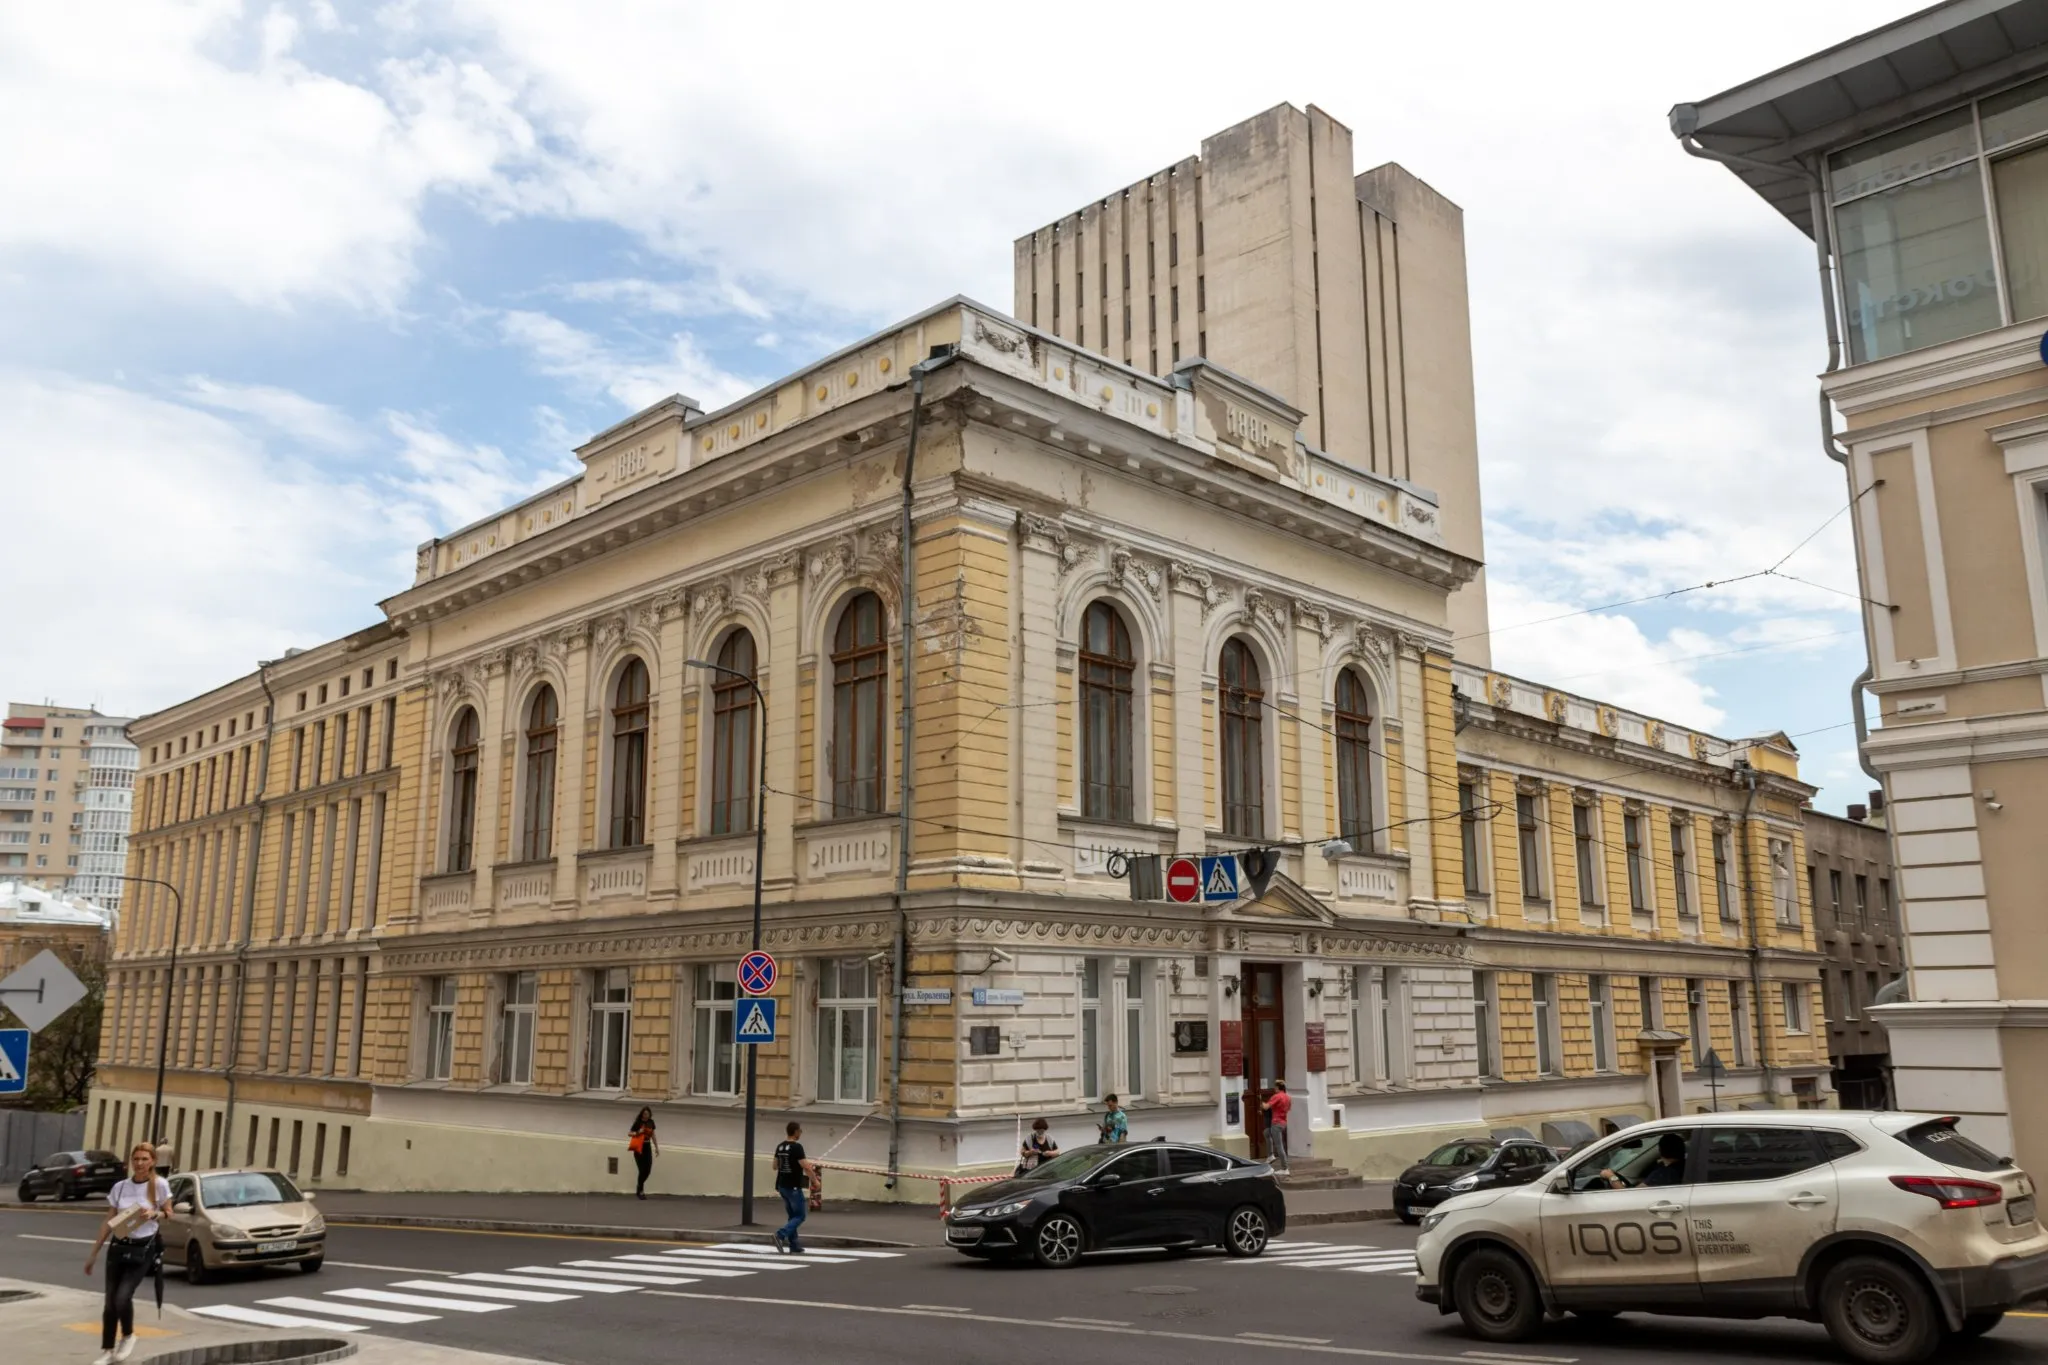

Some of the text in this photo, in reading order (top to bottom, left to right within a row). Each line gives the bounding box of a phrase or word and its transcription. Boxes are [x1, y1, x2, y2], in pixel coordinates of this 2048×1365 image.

[975, 991, 985, 1001] 18
[1693, 1219, 1713, 1230] THIS
[1568, 1222, 1682, 1262] IQOS
[1695, 1232, 1735, 1242] CHANGES
[1697, 1244, 1751, 1255] EVERYTHING
